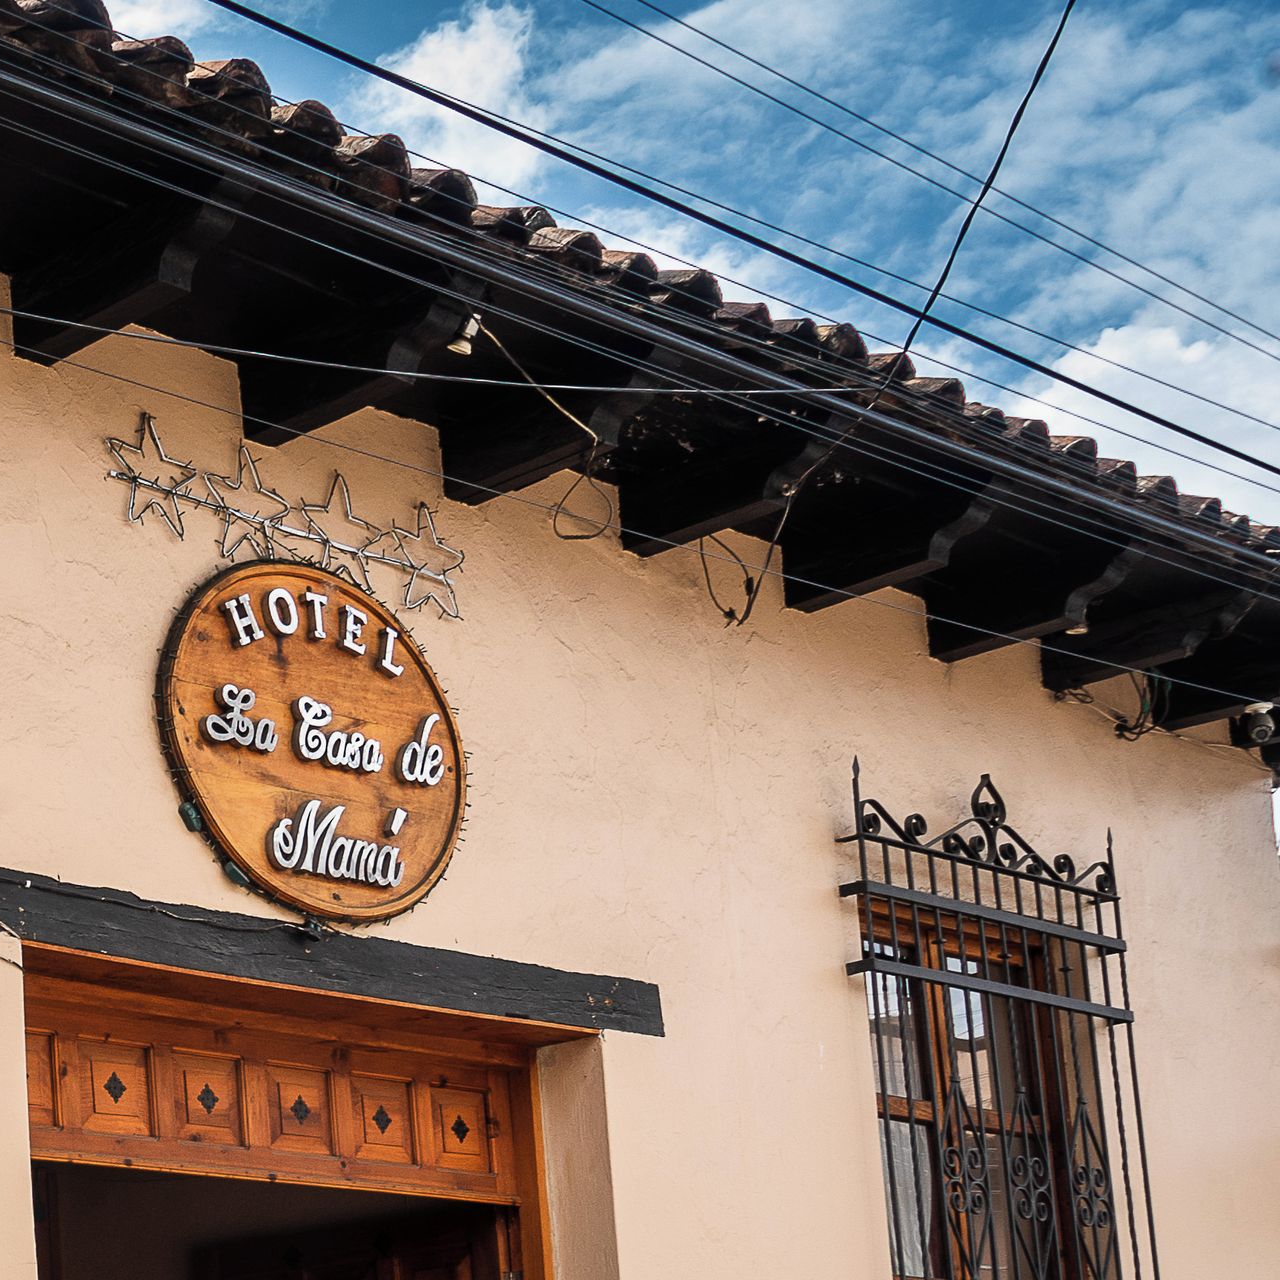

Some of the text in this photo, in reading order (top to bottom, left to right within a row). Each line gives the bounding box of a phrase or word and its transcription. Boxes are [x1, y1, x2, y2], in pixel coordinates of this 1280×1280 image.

[224, 587, 404, 677] HOTEL
[204, 683, 444, 787] La Casa de
[270, 799, 408, 888] Mamá
